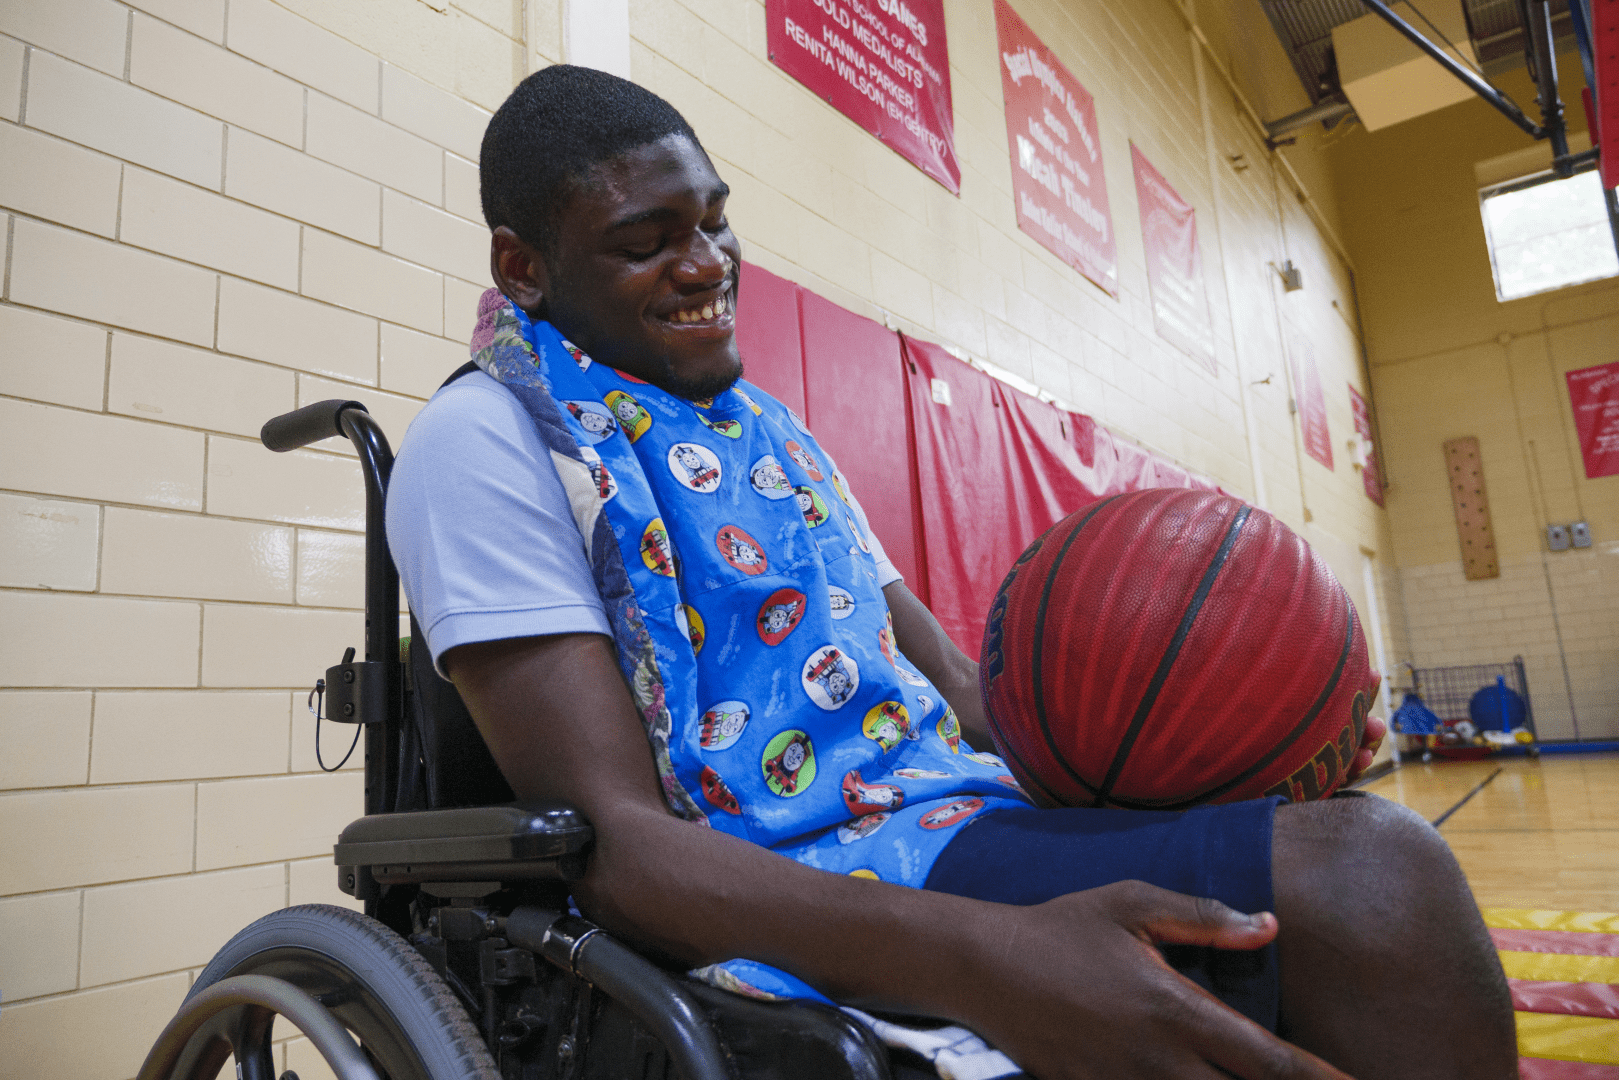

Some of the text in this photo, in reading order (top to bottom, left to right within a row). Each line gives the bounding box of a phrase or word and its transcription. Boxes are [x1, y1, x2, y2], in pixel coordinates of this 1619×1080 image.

[785, 17, 835, 71] RENITA
[836, 57, 885, 108] WILSON
[823, 25, 914, 113] HANNA PARKER
[853, 19, 923, 89] MEDALISTS
[891, 33, 905, 50] OF
